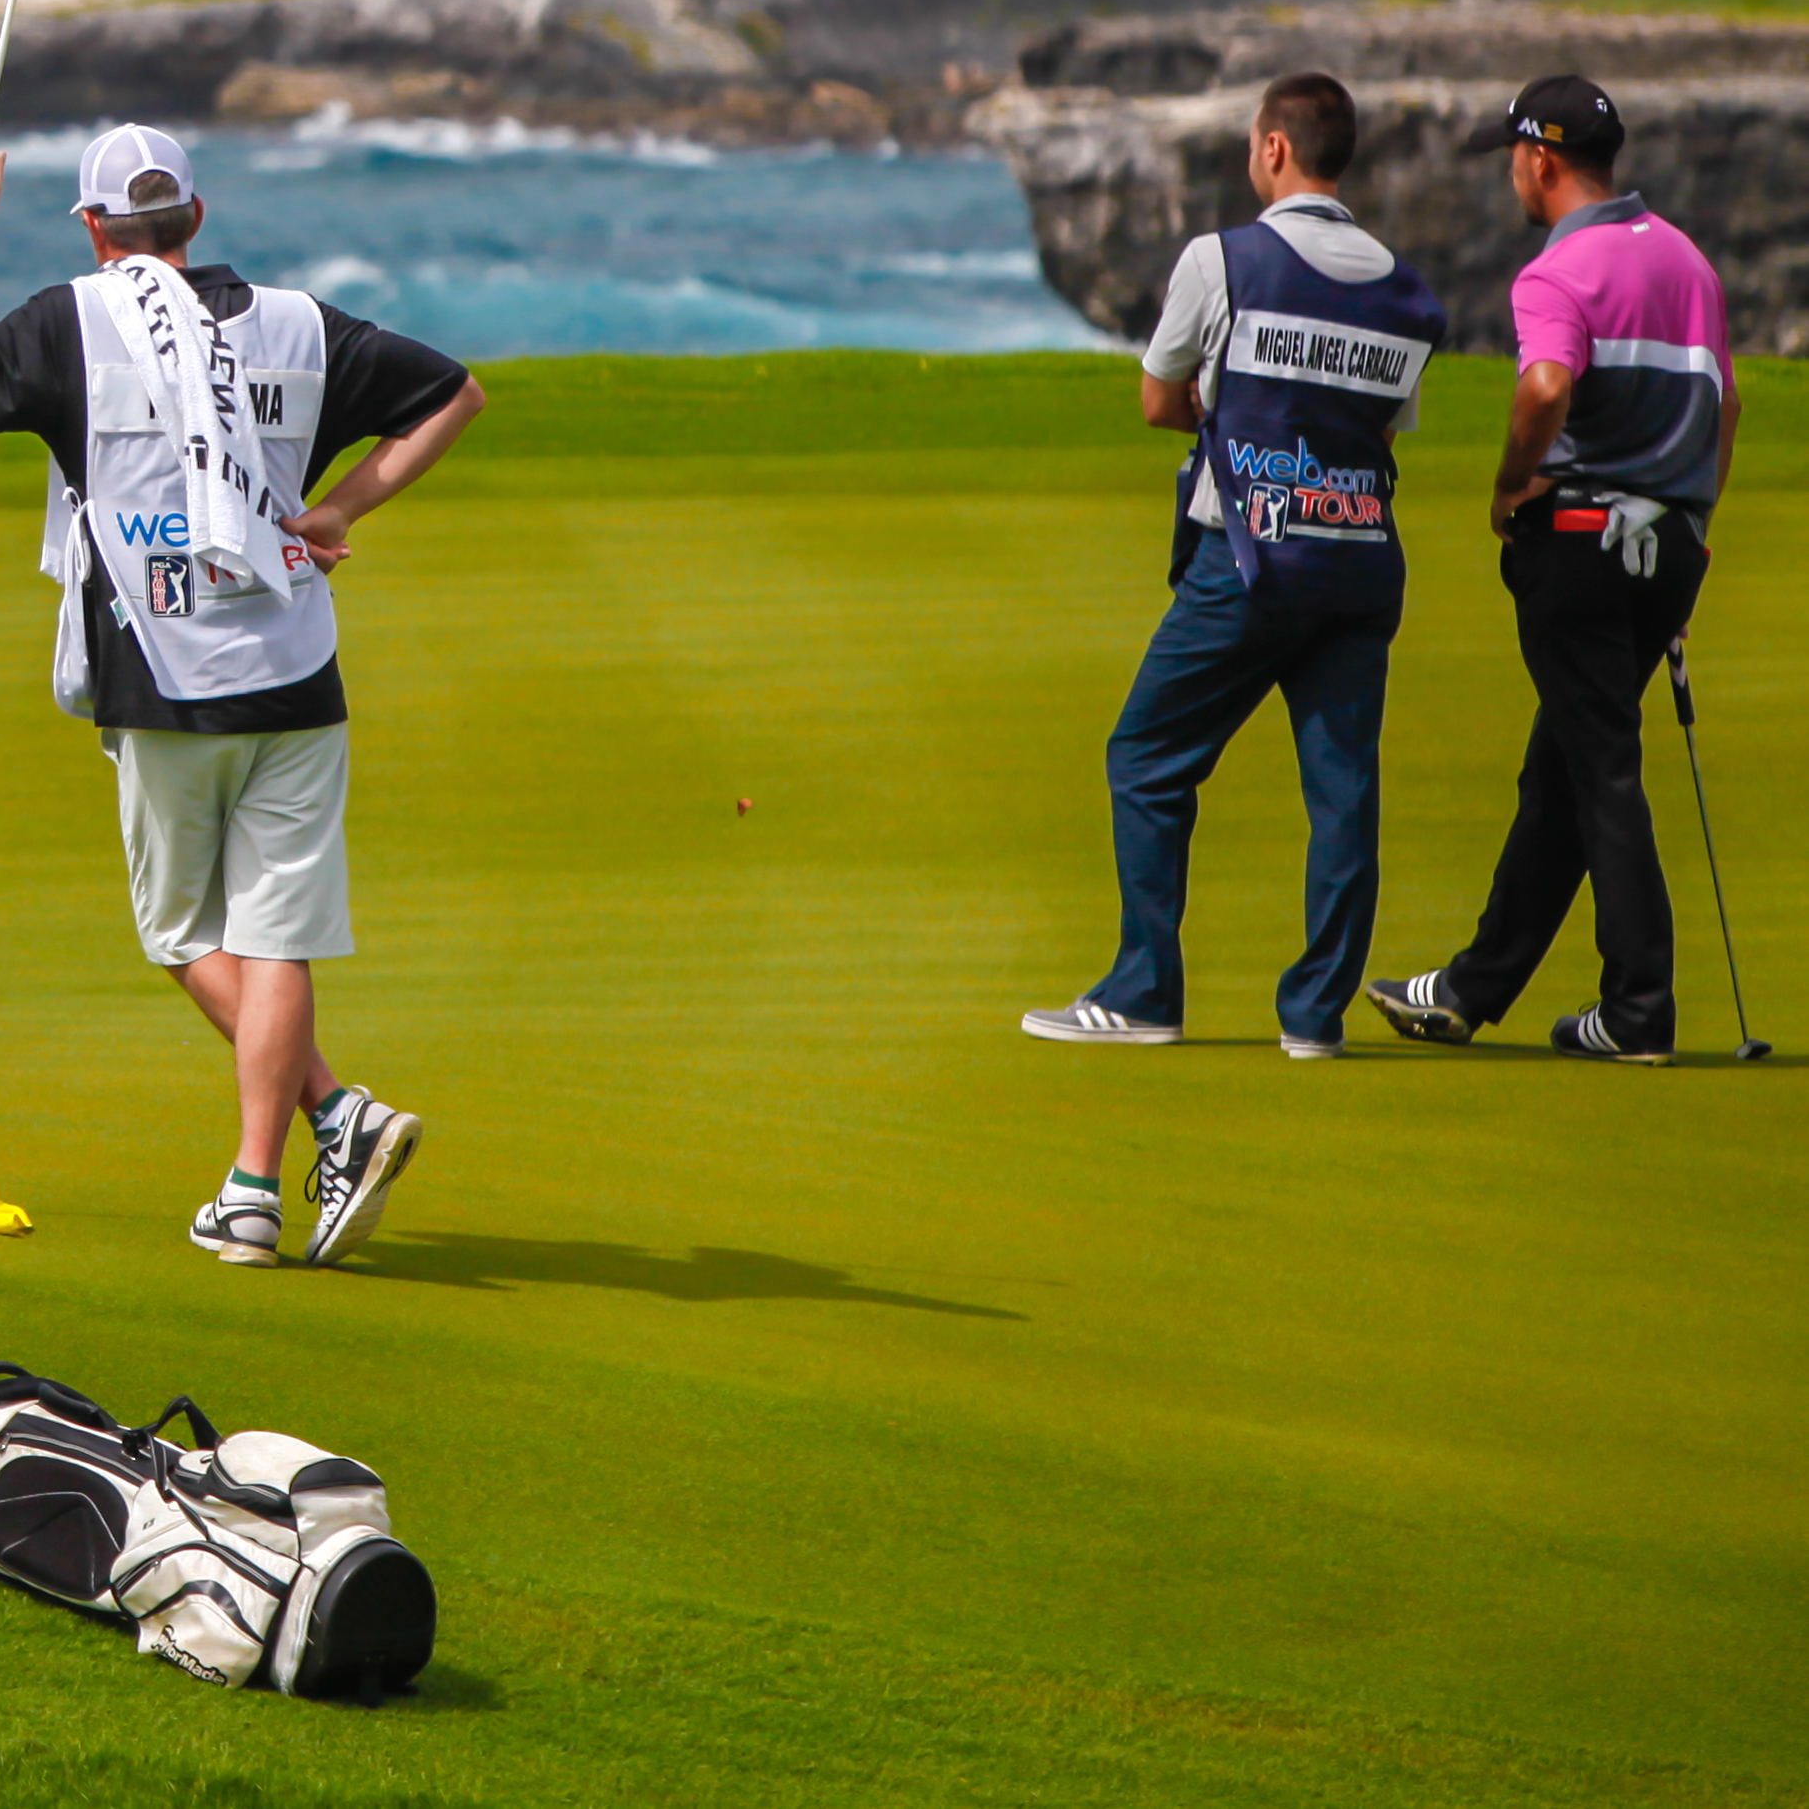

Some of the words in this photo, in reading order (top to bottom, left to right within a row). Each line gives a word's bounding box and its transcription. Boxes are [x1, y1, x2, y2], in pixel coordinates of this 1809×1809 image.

[1254, 326, 1305, 368] MIGUEL
[1306, 333, 1347, 375] ANGEL
[1347, 340, 1409, 387] CARBALLO
[1228, 435, 1377, 494] web.com
[1293, 487, 1384, 526] TOUR
[152, 561, 172, 569] PGA
[151, 568, 167, 612] TOUR
